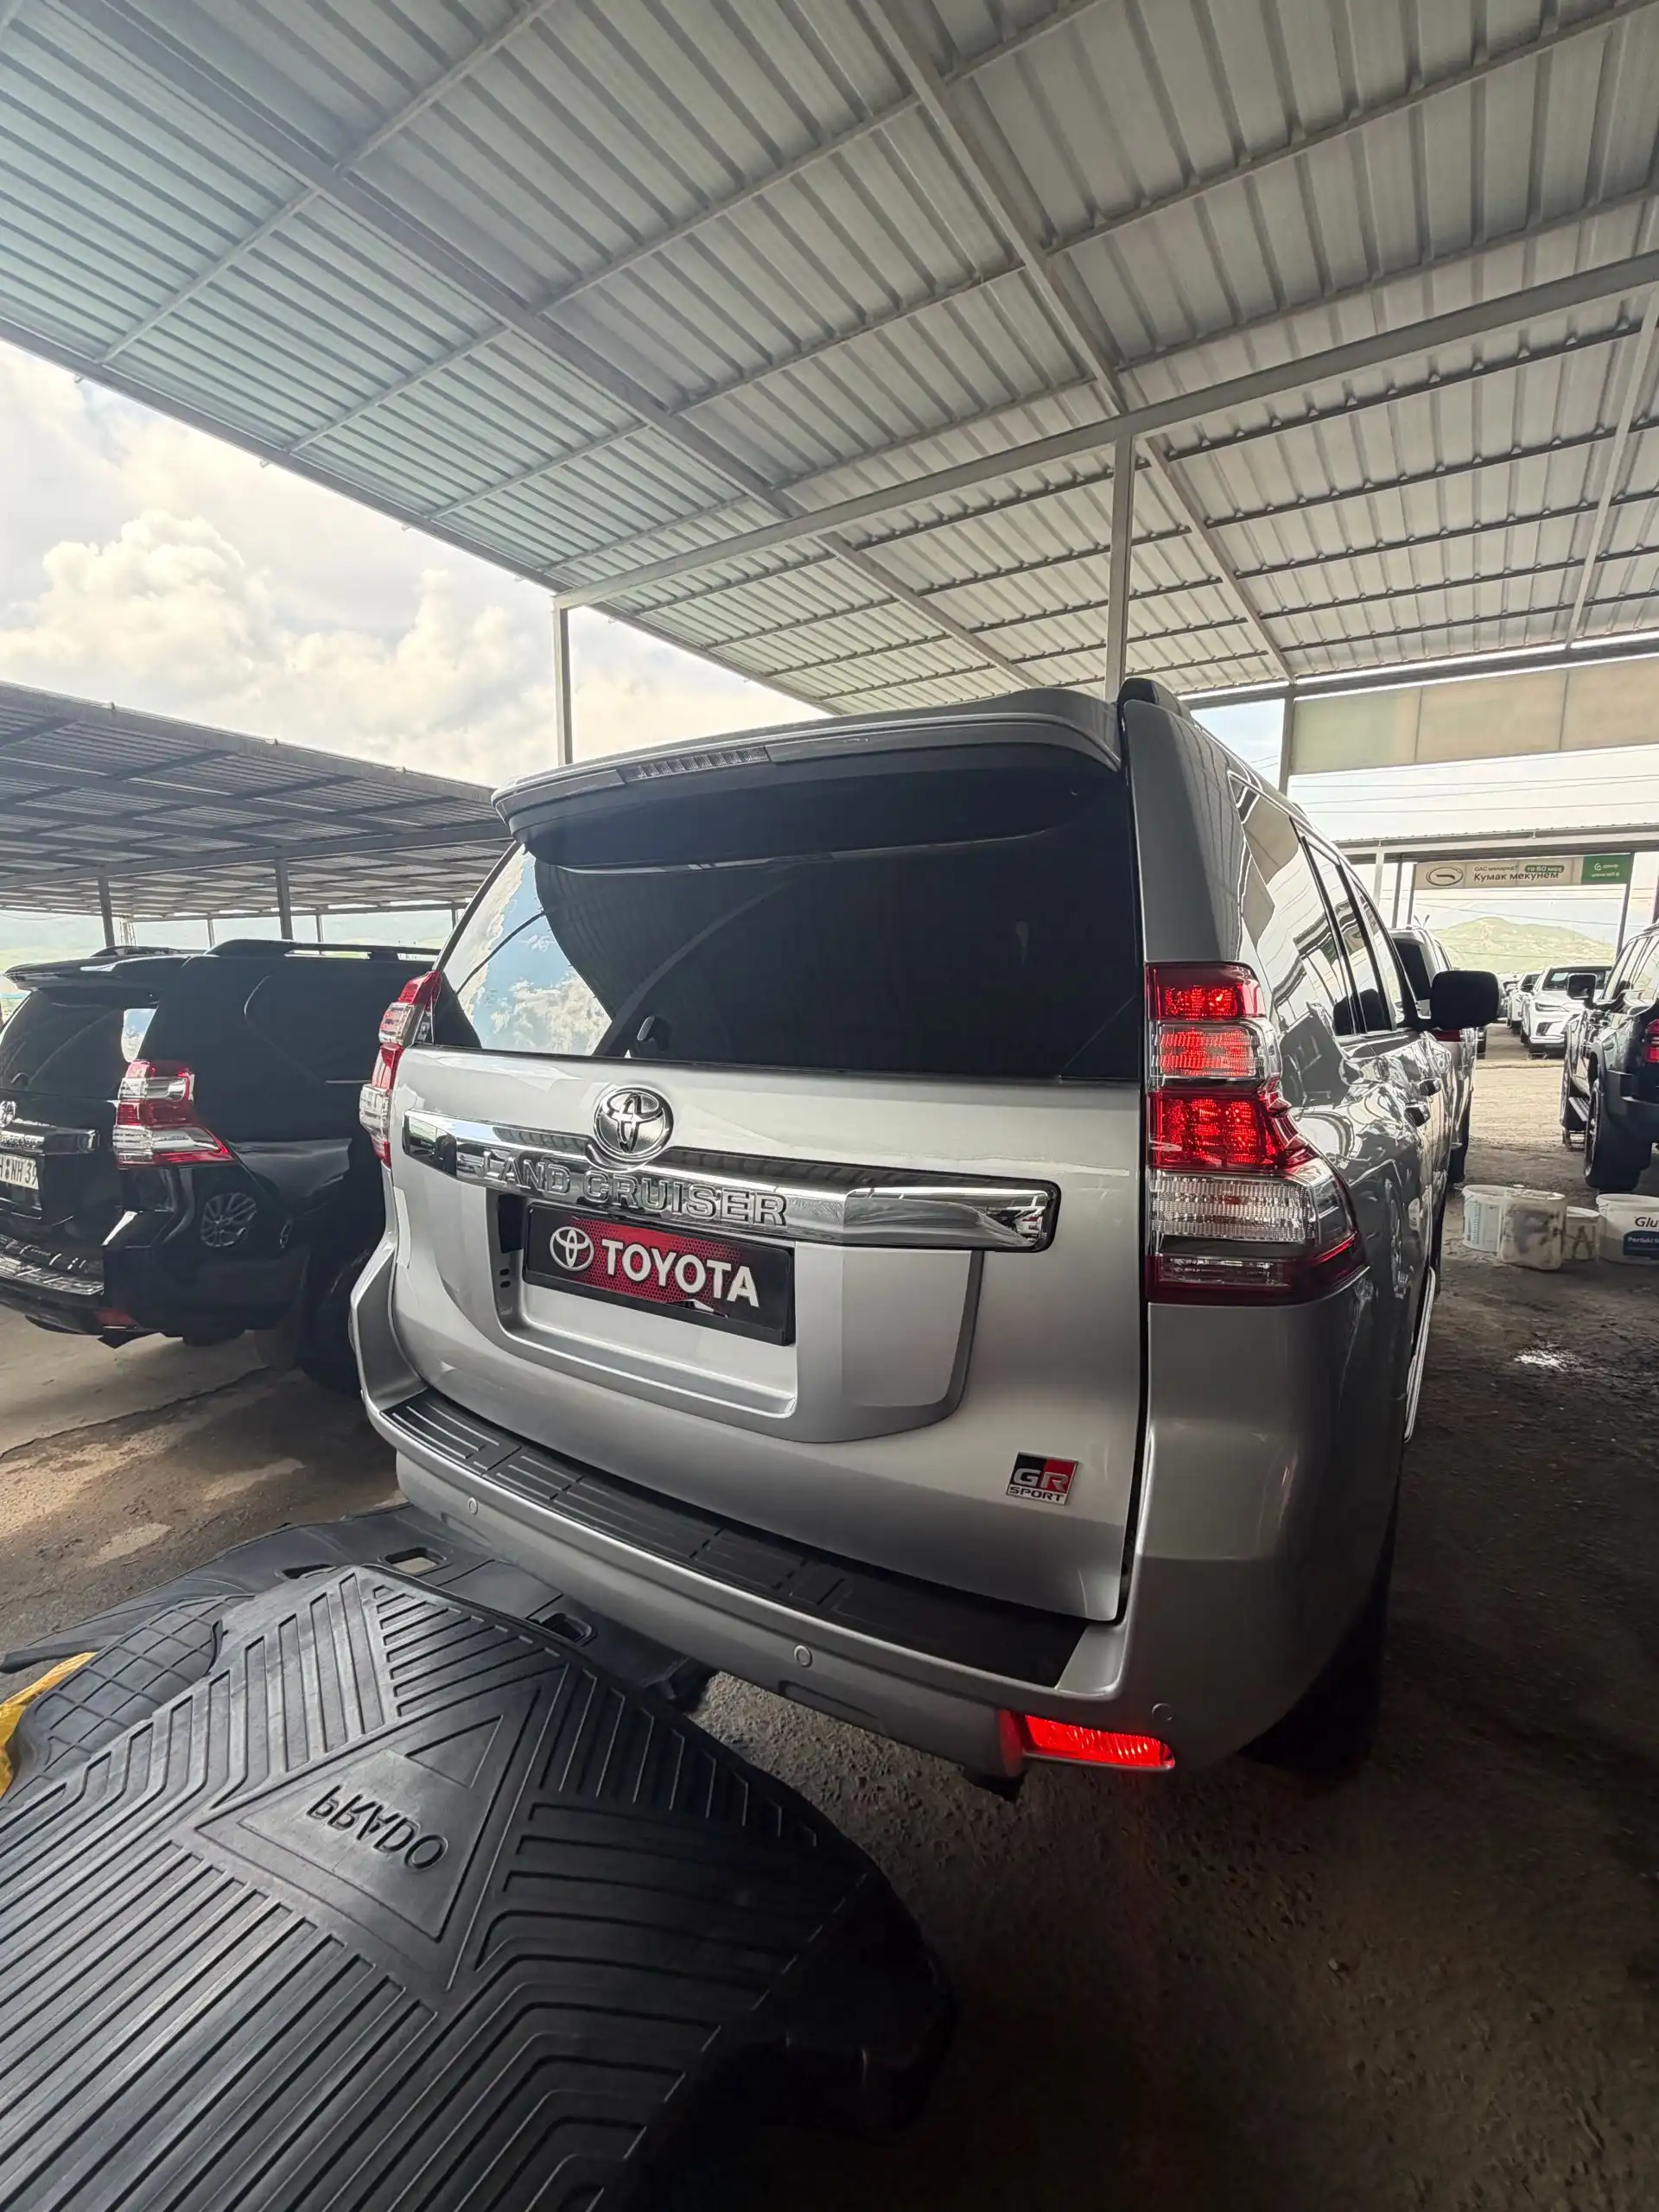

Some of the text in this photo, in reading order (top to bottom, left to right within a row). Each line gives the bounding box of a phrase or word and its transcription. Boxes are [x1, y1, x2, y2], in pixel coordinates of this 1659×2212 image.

[1474, 871, 1559, 882] Кумак мекунем
[11, 1159, 24, 1182] NH
[483, 1150, 788, 1227] LAND CRUISER
[1635, 1217, 1659, 1228] Glu
[601, 1238, 760, 1308] TOYOTA
[1013, 1467, 1069, 1492] GR
[1009, 1486, 1065, 1502] SPORT
